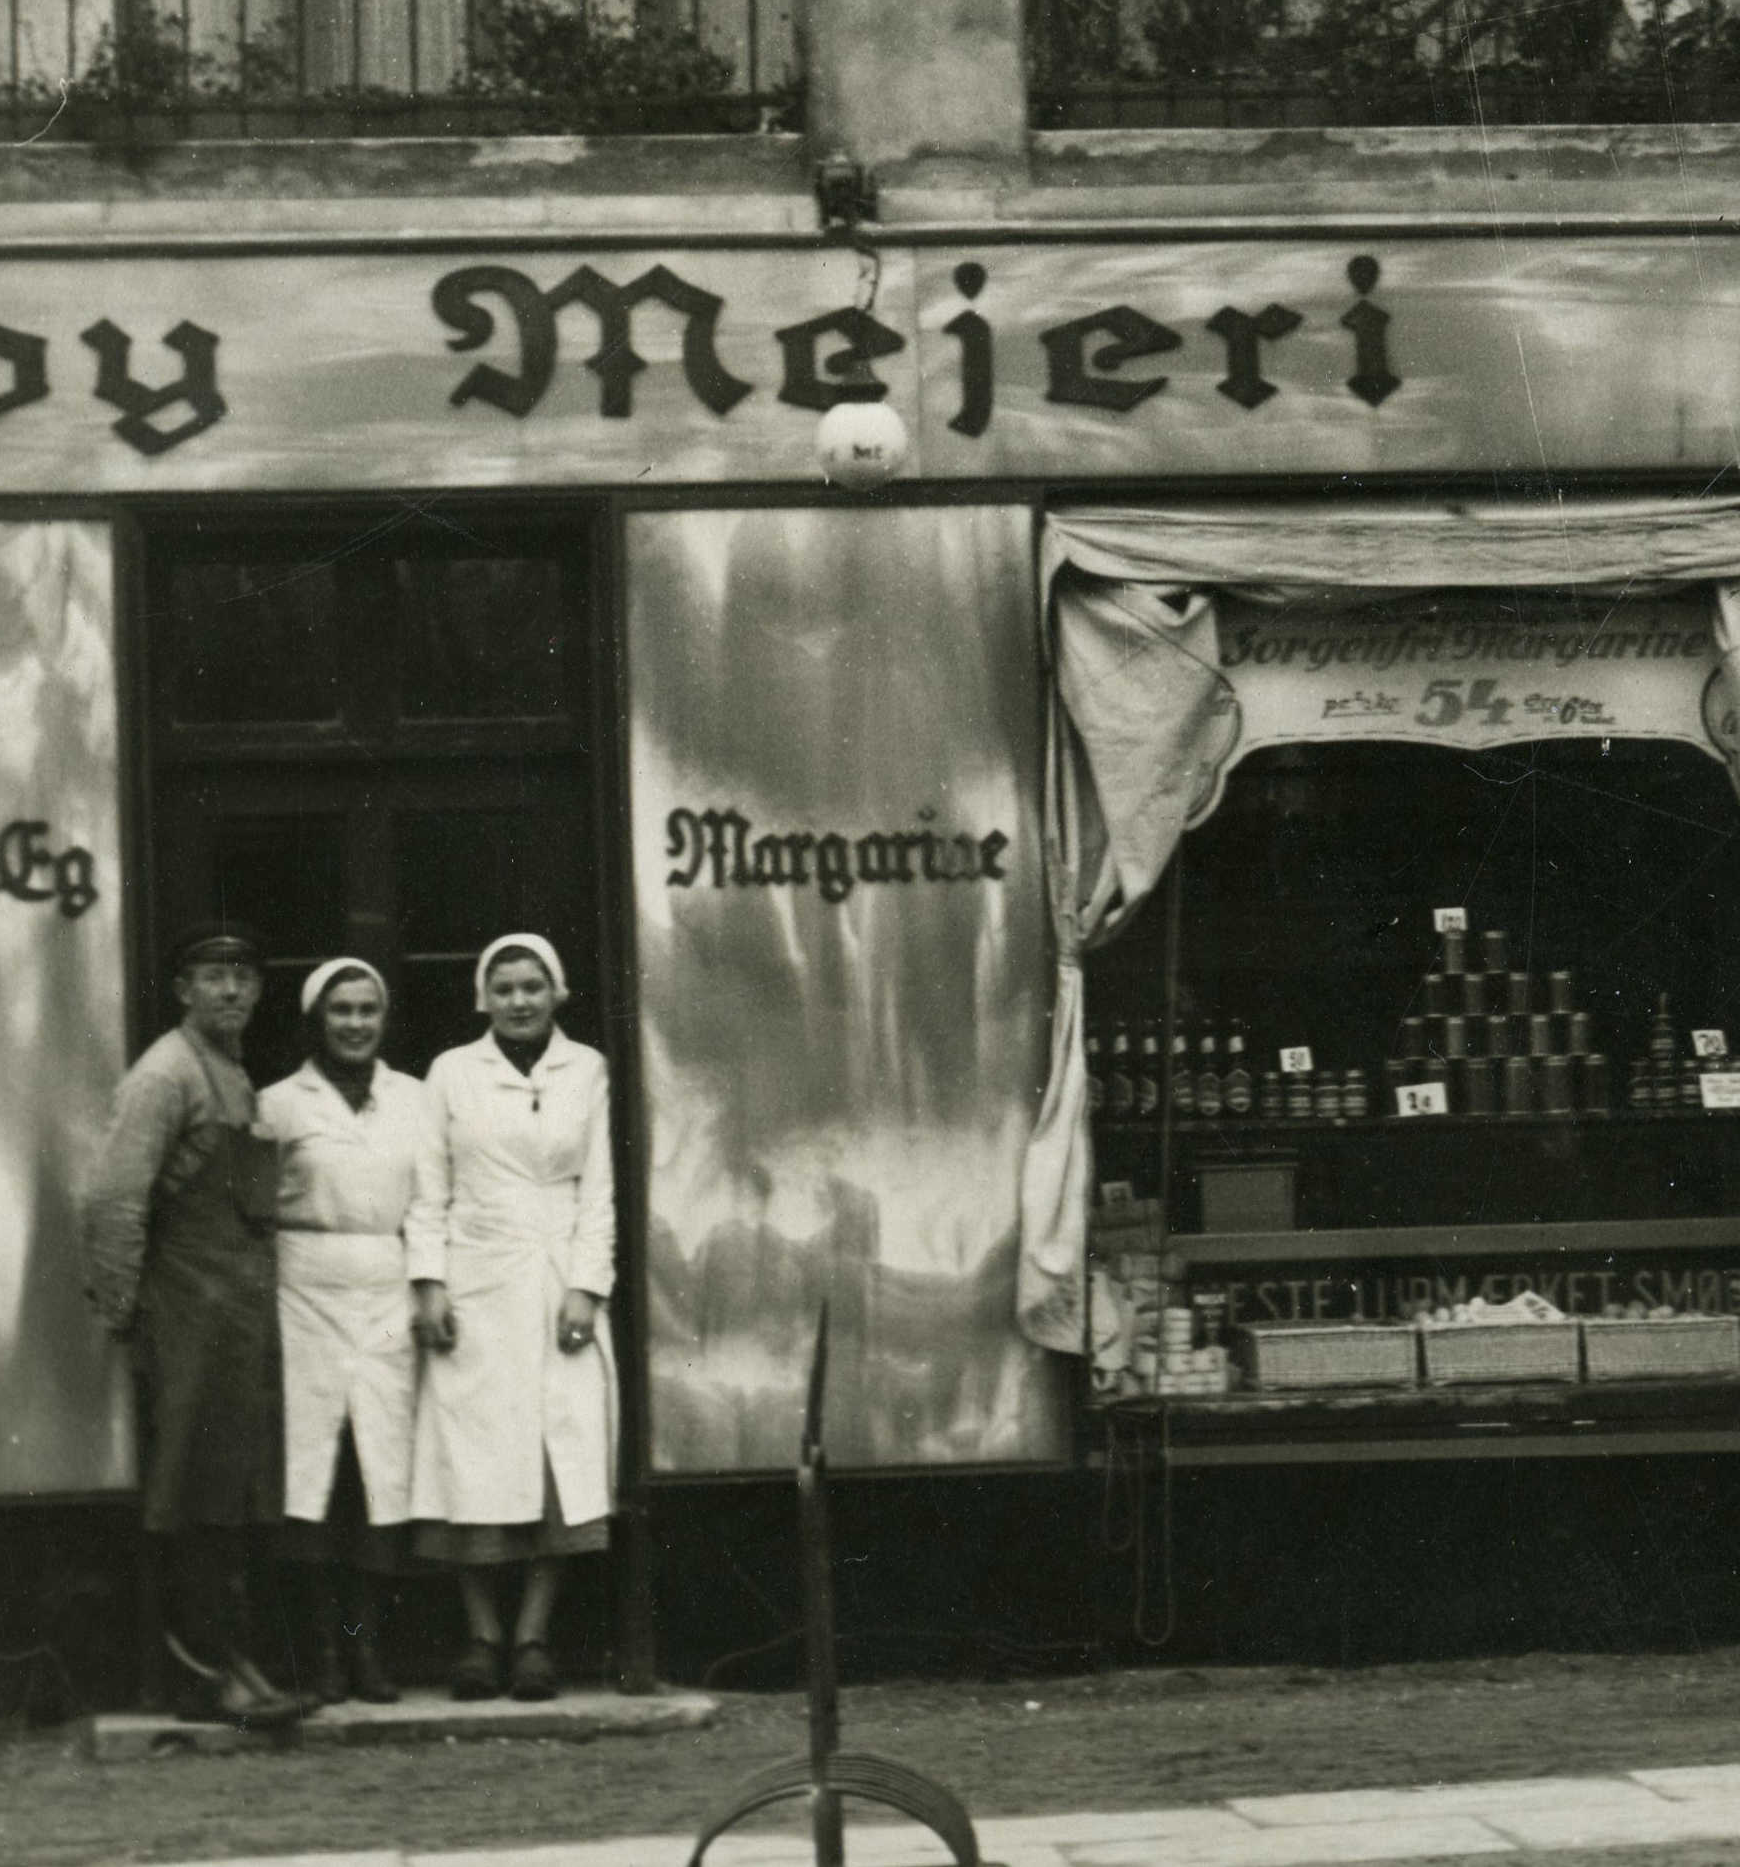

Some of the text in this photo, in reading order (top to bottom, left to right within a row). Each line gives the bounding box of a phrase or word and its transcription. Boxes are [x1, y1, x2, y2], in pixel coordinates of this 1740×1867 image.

[431, 254, 1403, 438] Mejeri
[665, 805, 1009, 904] Margarine
[1632, 1266, 1728, 1319] SMØ
